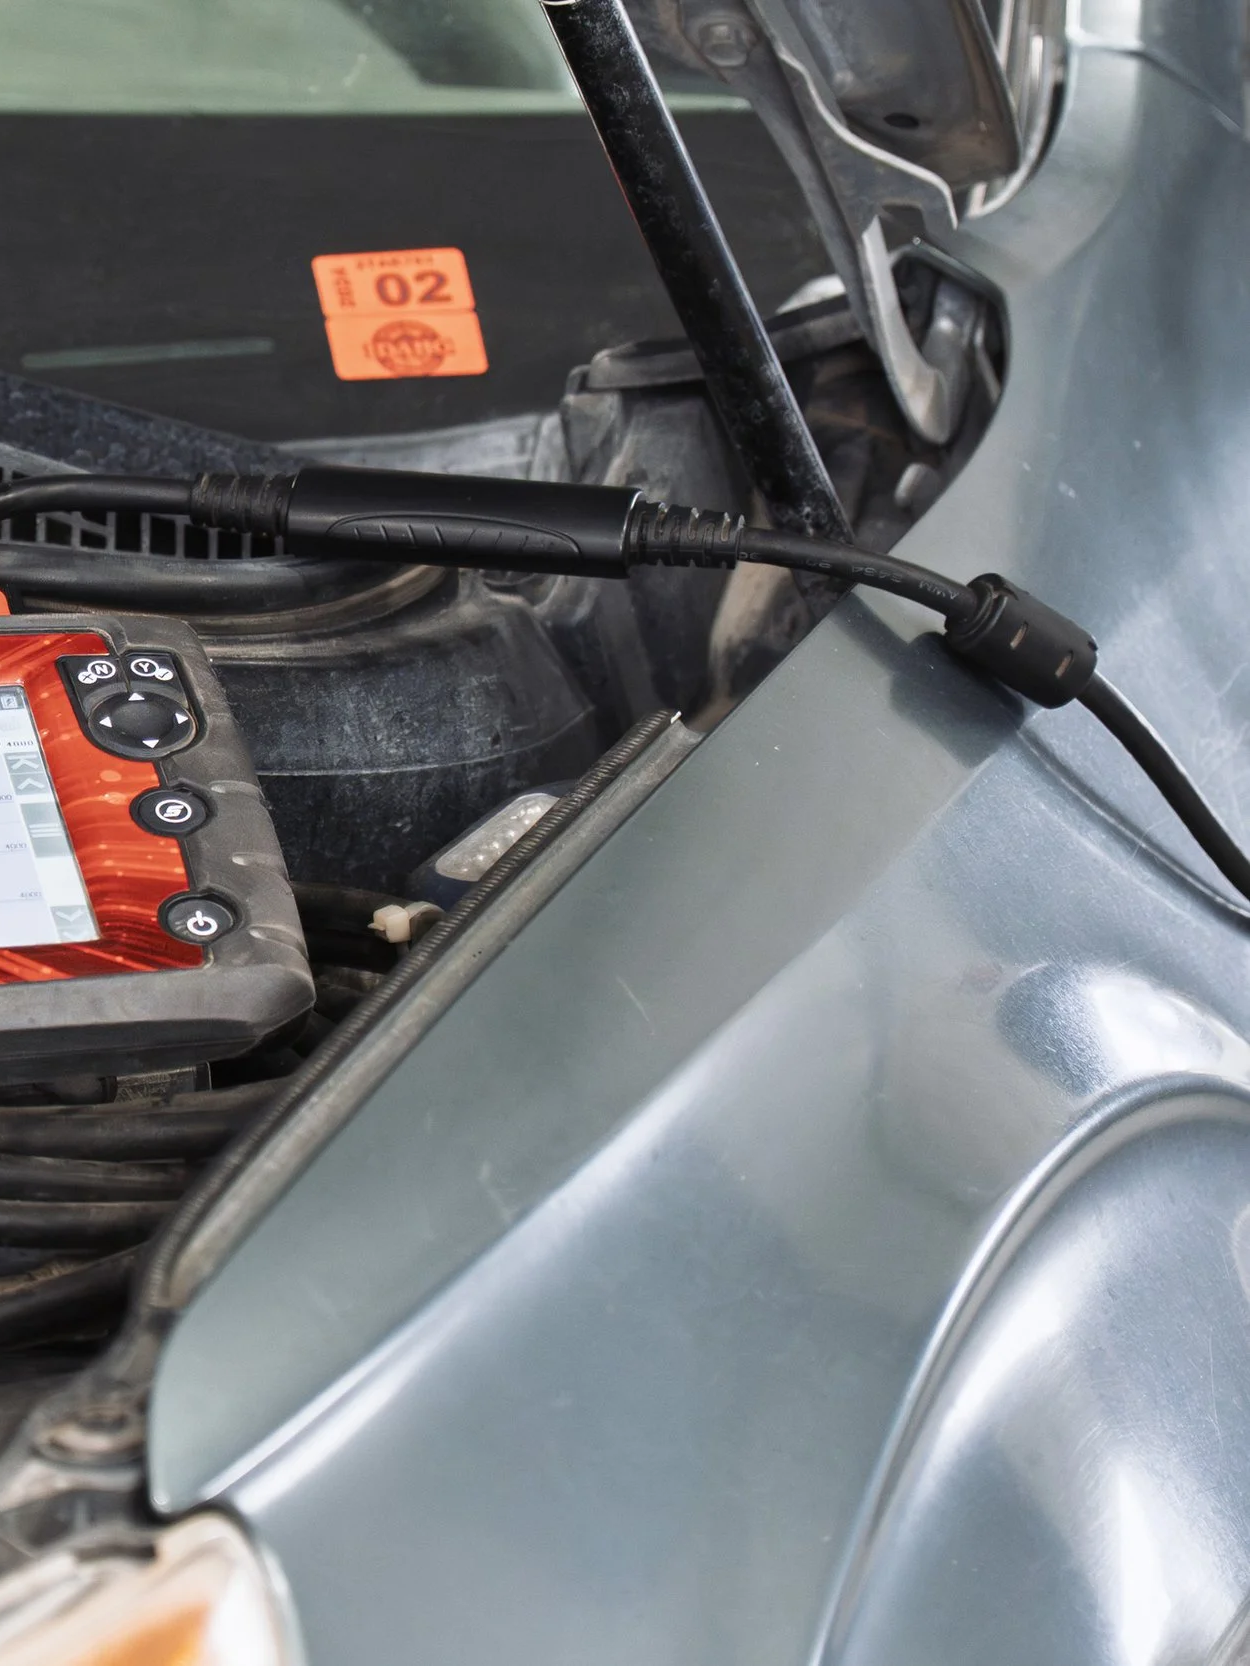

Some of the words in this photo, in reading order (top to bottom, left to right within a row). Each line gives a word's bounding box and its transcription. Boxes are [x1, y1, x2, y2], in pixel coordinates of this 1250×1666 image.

[375, 270, 453, 308] 02
[94, 664, 109, 675] N
[138, 662, 150, 673] Y
